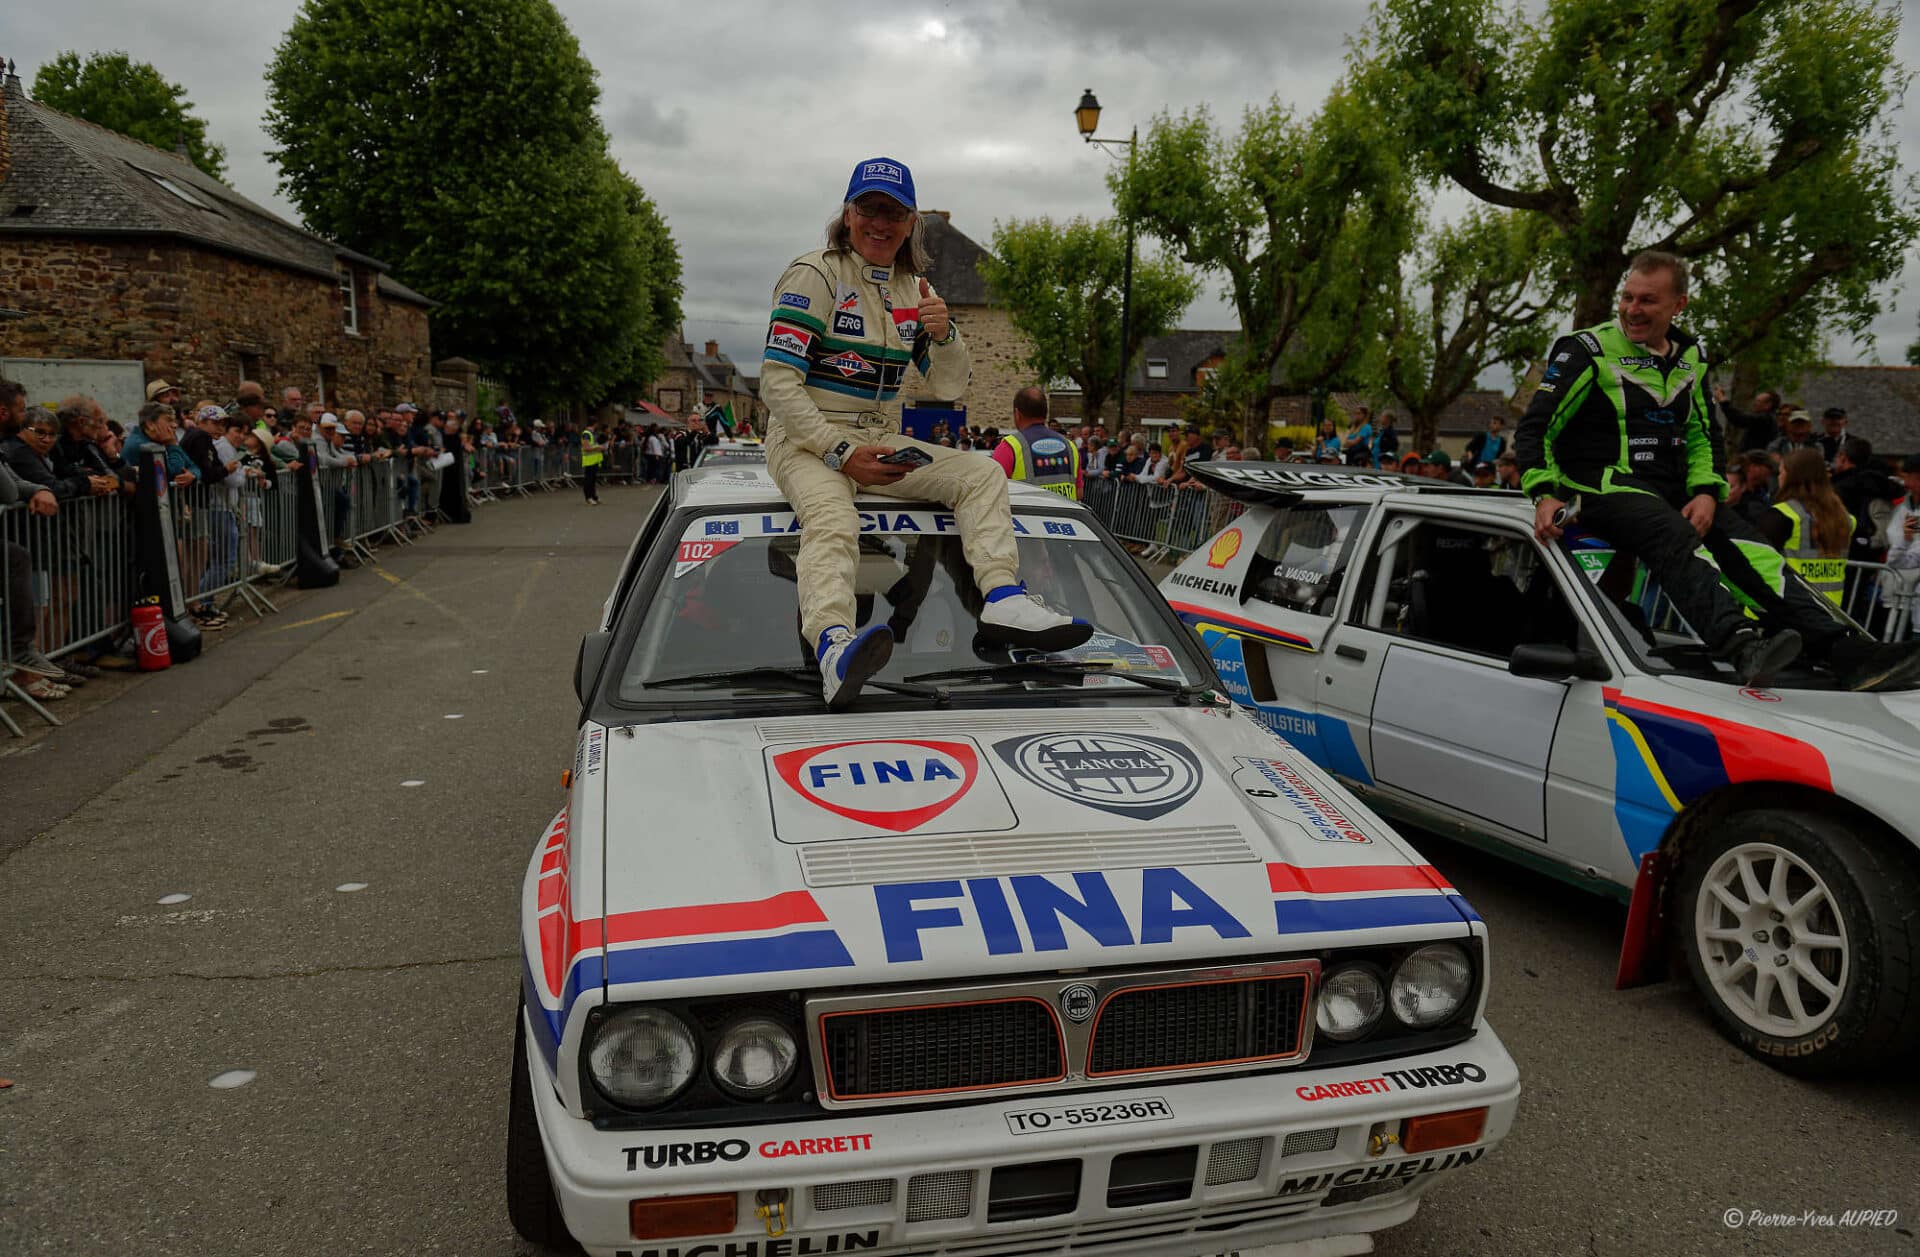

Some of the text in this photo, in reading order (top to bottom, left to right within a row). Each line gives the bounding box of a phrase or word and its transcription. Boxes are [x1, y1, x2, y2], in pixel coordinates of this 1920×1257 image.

[837, 316, 862, 330] ERG
[774, 335, 803, 354] Marlboro
[1216, 467, 1403, 489] PEUGEOT
[682, 543, 713, 560] 102
[1580, 554, 1603, 568] 54
[1171, 572, 1237, 598] MICHELIN
[1259, 711, 1317, 737] BILSTEIN
[809, 758, 960, 788] FINA
[1061, 756, 1153, 778] LANCIA
[873, 867, 1253, 964] FINA
[1296, 1063, 1487, 1101] GARRETT TURBO
[1010, 1101, 1169, 1130] TO-55236R
[622, 1134, 873, 1171] TURBO GARRETT
[1279, 1147, 1487, 1194] MICHELIN
